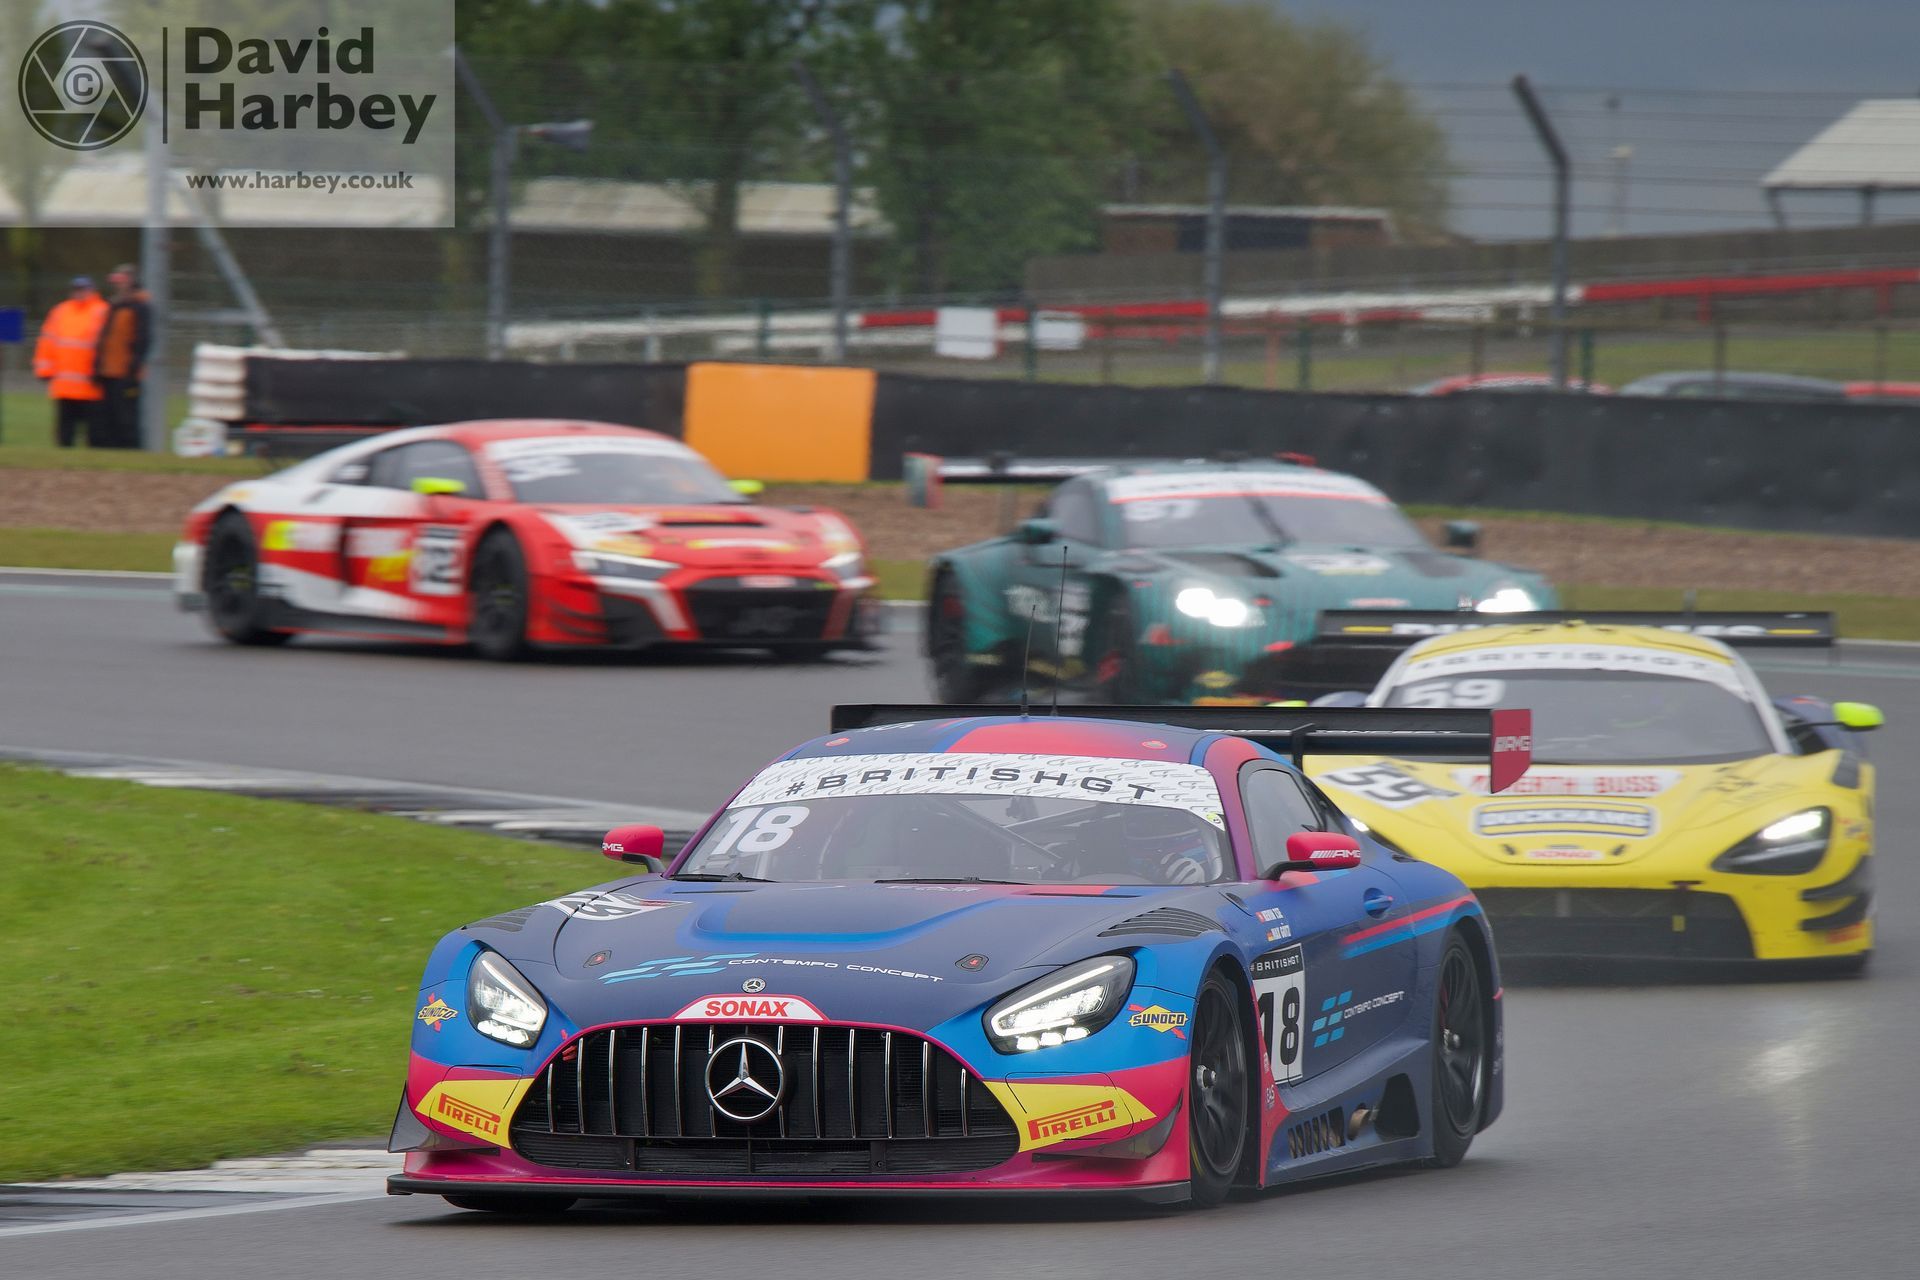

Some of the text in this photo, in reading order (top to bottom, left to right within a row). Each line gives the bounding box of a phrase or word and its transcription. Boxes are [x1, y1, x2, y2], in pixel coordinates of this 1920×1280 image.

[1402, 678, 1506, 708] 59
[786, 767, 1155, 799] #BRITISHGT
[1322, 763, 1461, 803] 59
[711, 806, 810, 855] 18
[728, 958, 943, 982] CONTEMPO CONCEPT
[1250, 955, 1299, 971] #BRITISHGT
[419, 1006, 454, 1019] SUNOCO
[705, 1000, 789, 1017] SONAX
[1132, 1013, 1185, 1025] SUNOCO
[1257, 986, 1300, 1066] 18
[438, 1092, 501, 1136] PIRELLI
[1028, 1099, 1116, 1141] PIRELLI
